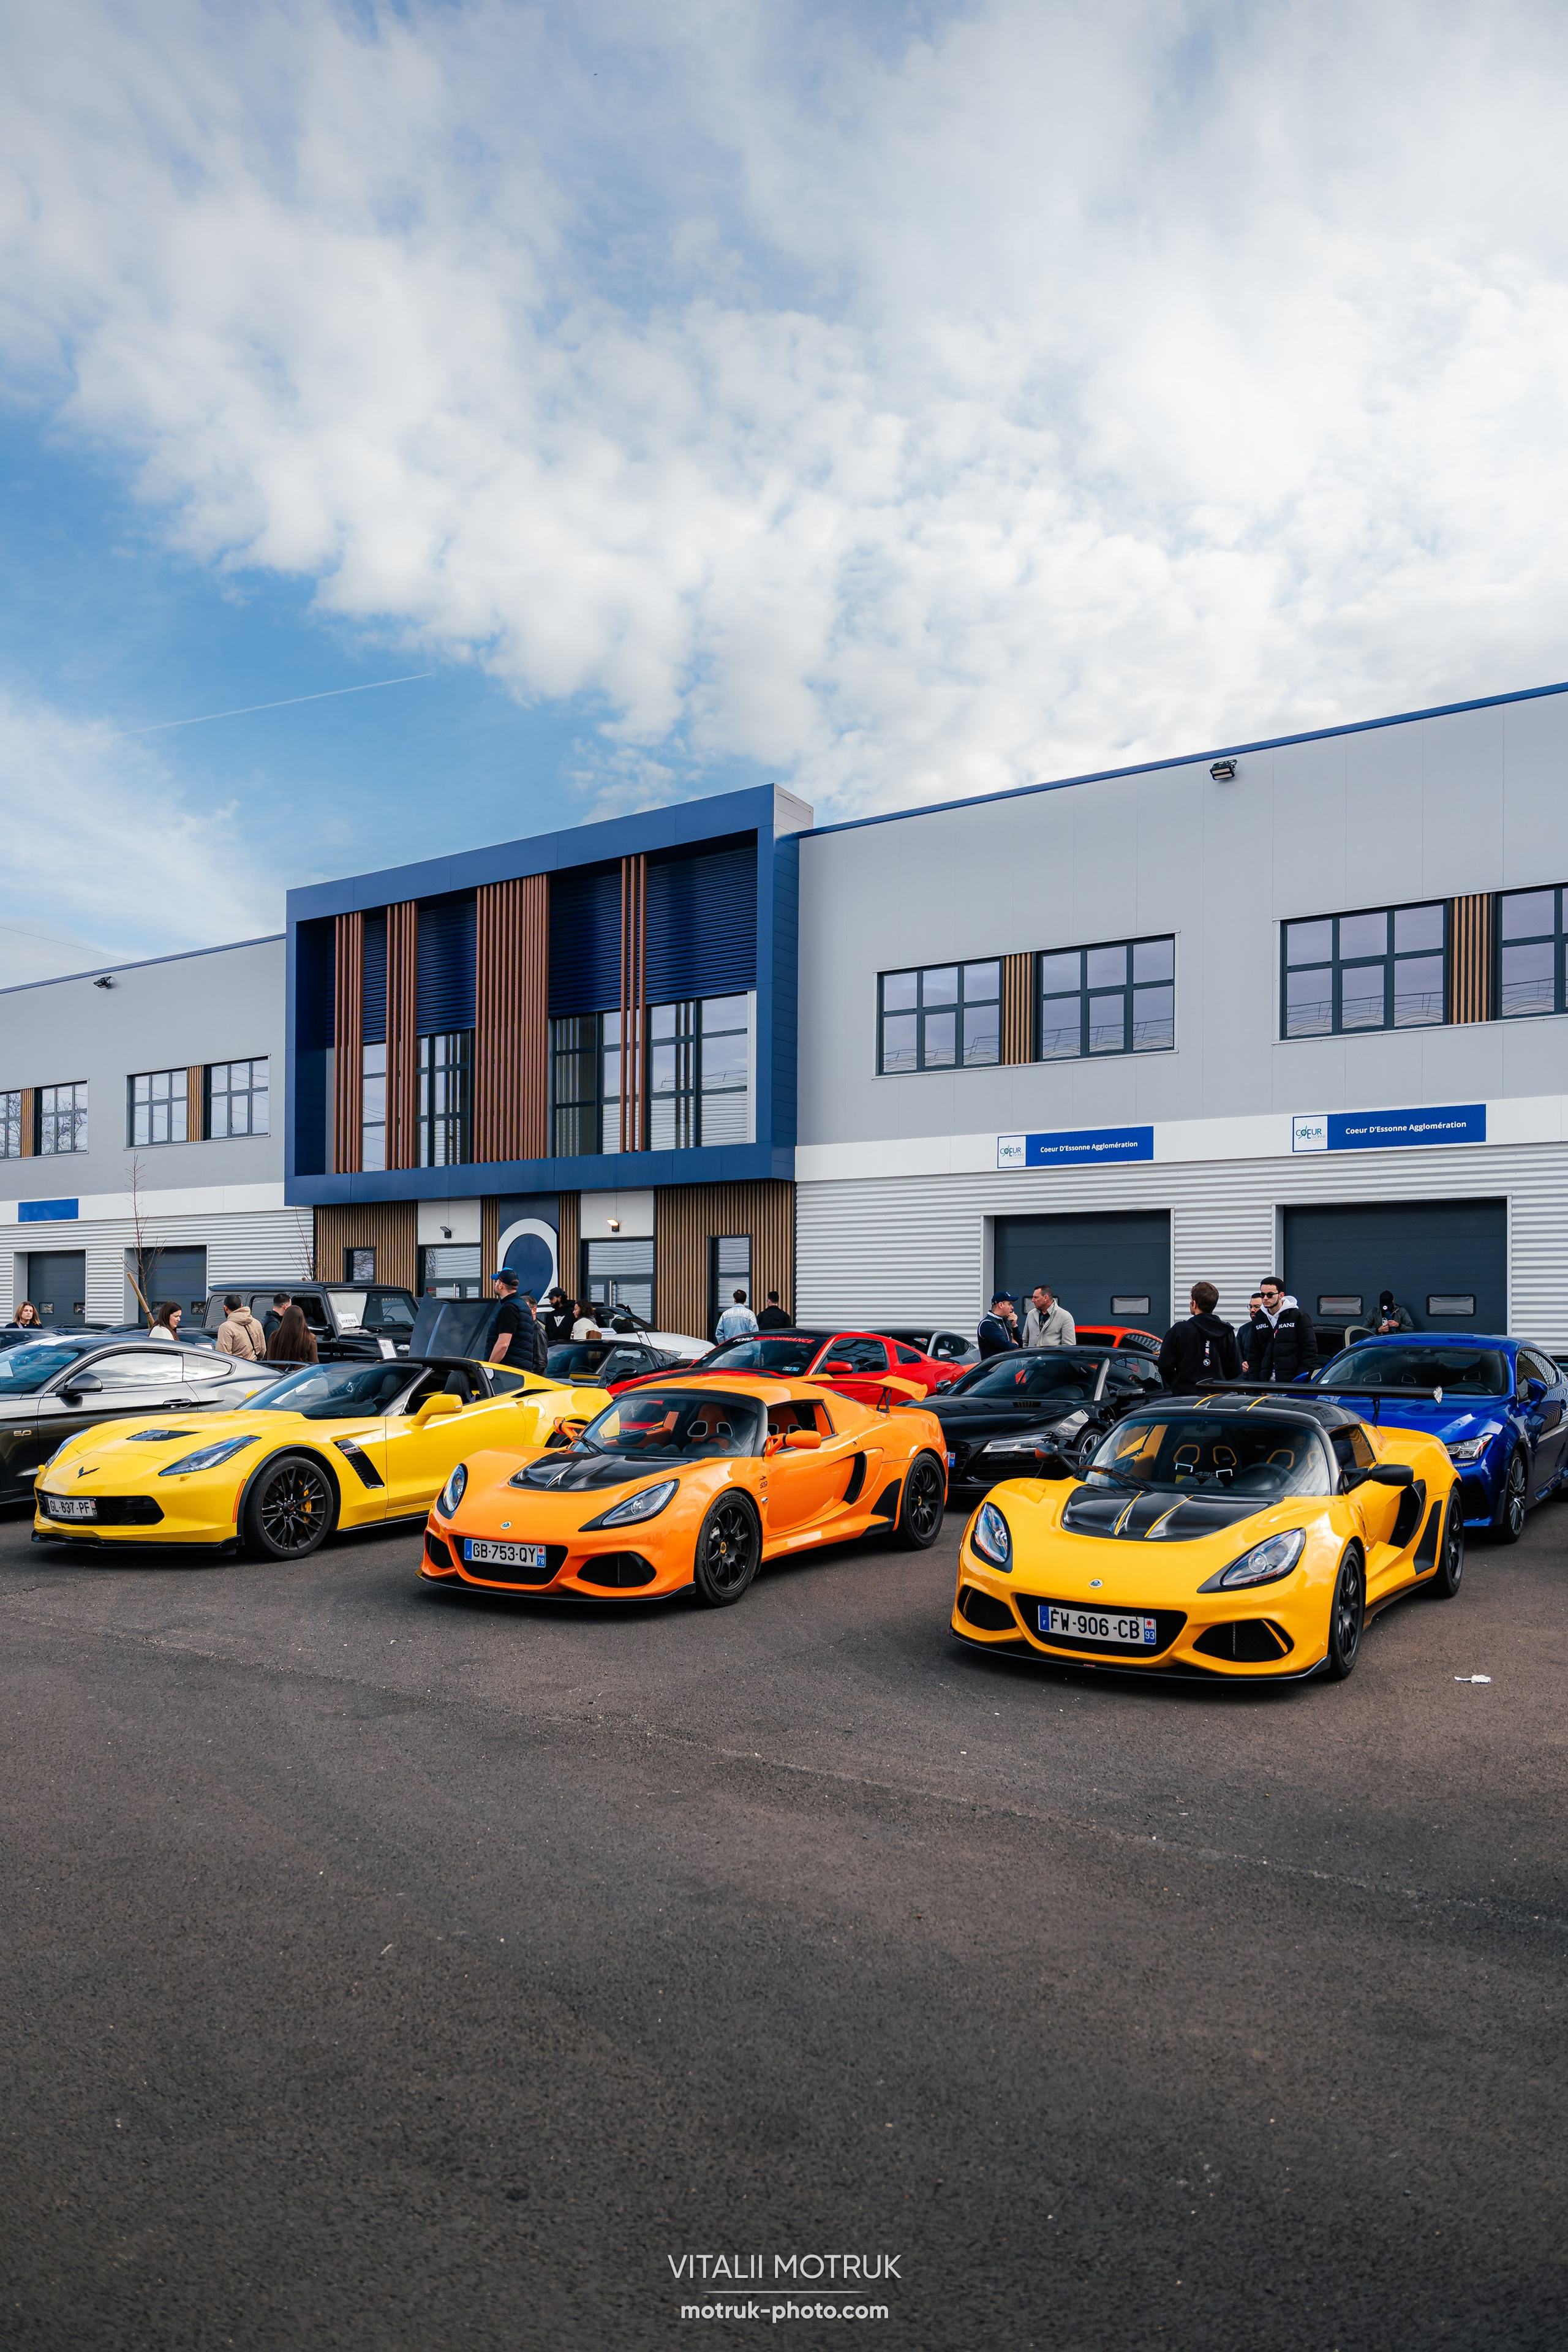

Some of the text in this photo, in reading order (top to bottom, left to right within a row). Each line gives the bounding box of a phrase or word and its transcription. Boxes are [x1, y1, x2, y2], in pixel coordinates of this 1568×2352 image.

[1369, 1125, 1407, 1133] D'Essonne
[1409, 1121, 1466, 1131] Agglomération
[1059, 1144, 1090, 1152] D'Essonne
[1091, 1141, 1138, 1150] Agglomération
[50, 1500, 90, 1514] GL-637-PF
[473, 1543, 536, 1562] GB-753-QY
[1050, 1610, 1140, 1639] FW-906-CB
[1145, 1630, 1155, 1640] 93
